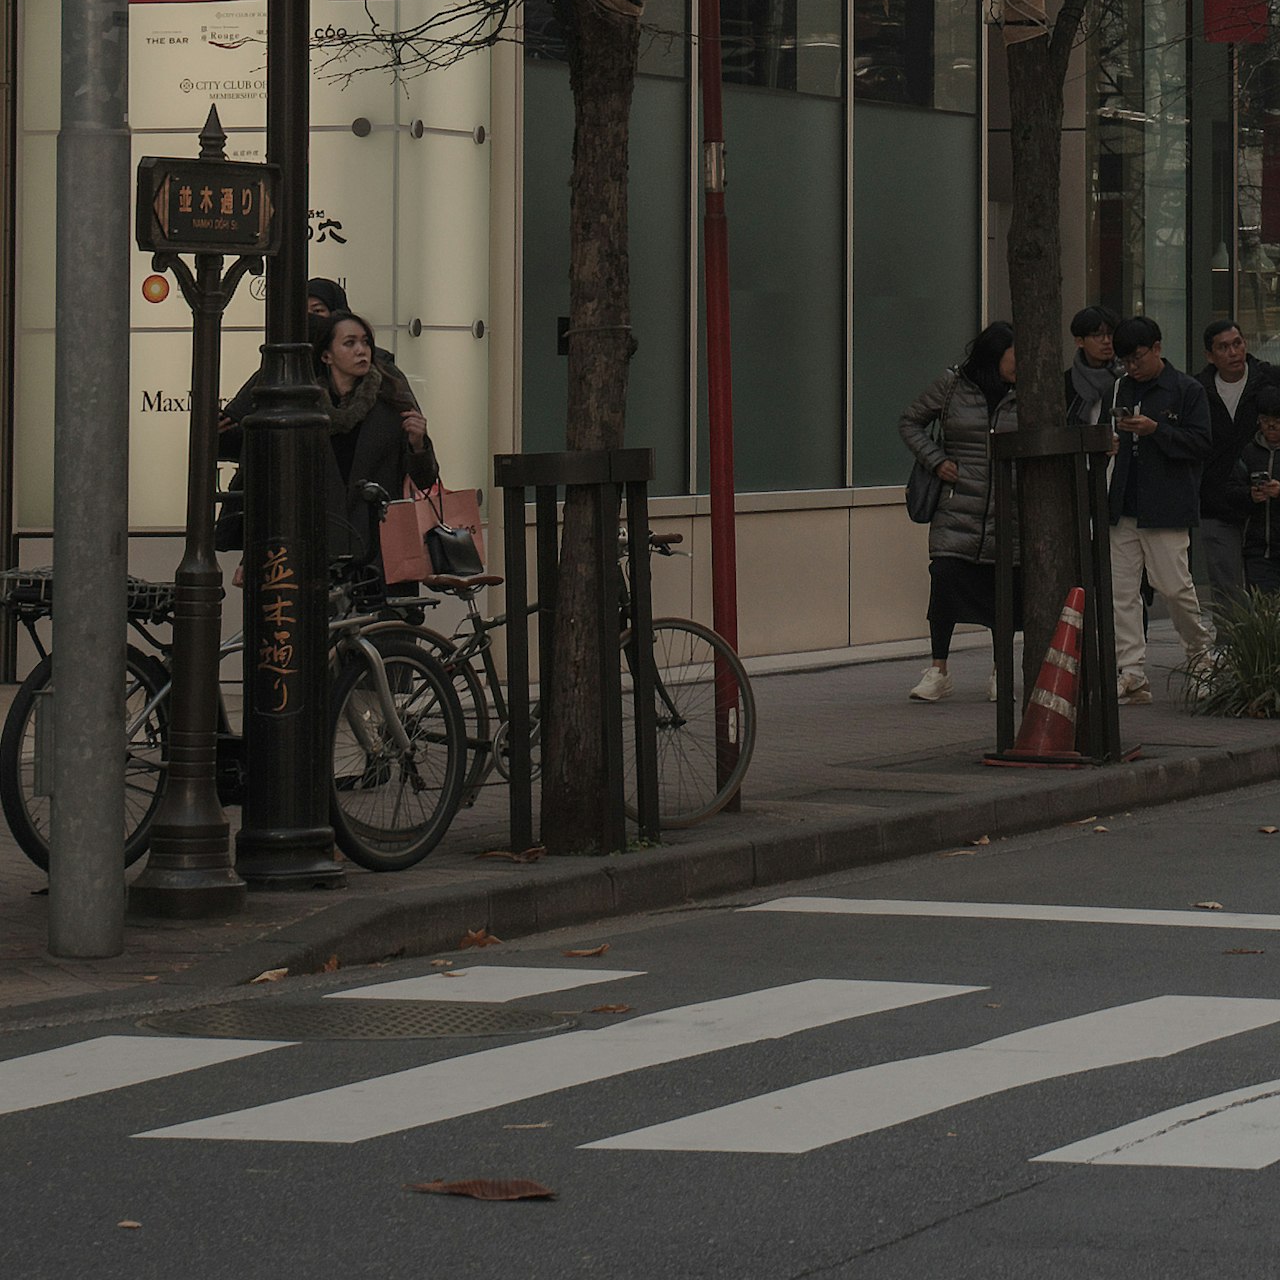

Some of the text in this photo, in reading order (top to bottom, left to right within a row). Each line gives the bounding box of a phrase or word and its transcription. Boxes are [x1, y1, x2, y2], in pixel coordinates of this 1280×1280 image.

[146, 37, 189, 45] THE BAR
[210, 31, 240, 40] Rouge
[195, 80, 221, 91] CITY
[223, 80, 252, 91] CLUB
[178, 185, 253, 216] 並木通り
[257, 546, 299, 714] 並木通り
